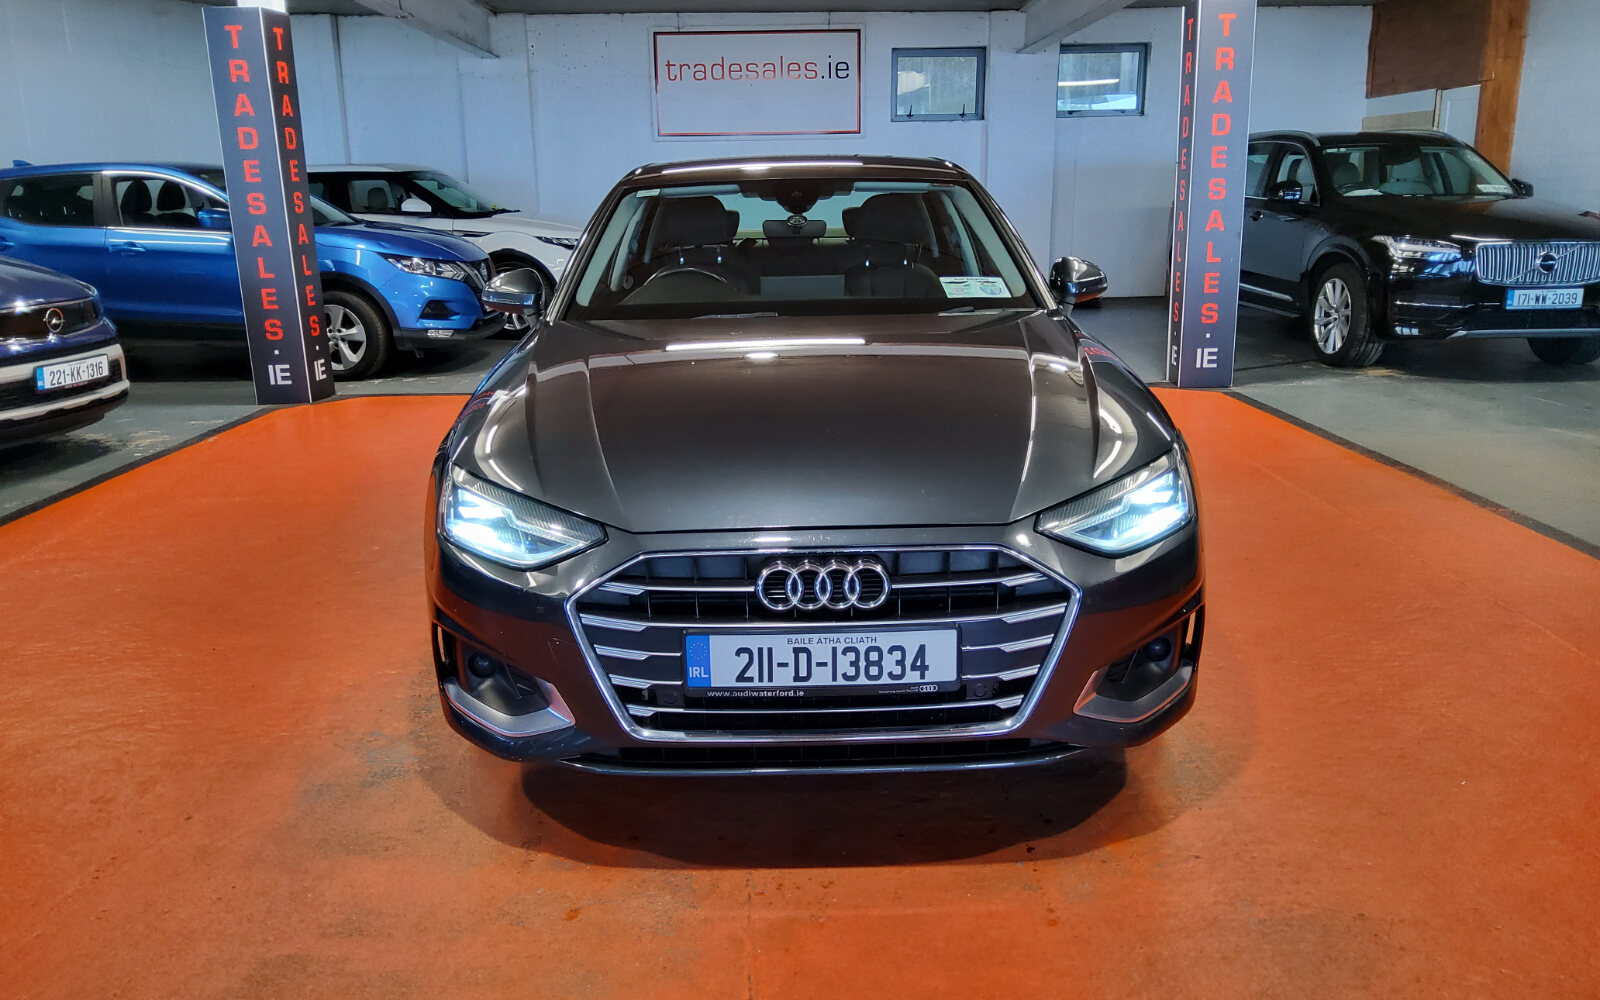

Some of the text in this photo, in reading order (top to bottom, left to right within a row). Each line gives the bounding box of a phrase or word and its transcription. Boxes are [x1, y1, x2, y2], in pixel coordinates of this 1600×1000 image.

[664, 55, 850, 82] tradesales.ie
[1517, 292, 1578, 306] 171-WW-2039
[49, 360, 104, 387] 221-KK-1316
[786, 635, 877, 645] BAILE ÁTHA CLIATH
[734, 643, 930, 684] 211-D-13834
[688, 666, 709, 678] IRL
[707, 689, 805, 698] www.audiwaterford.ie
